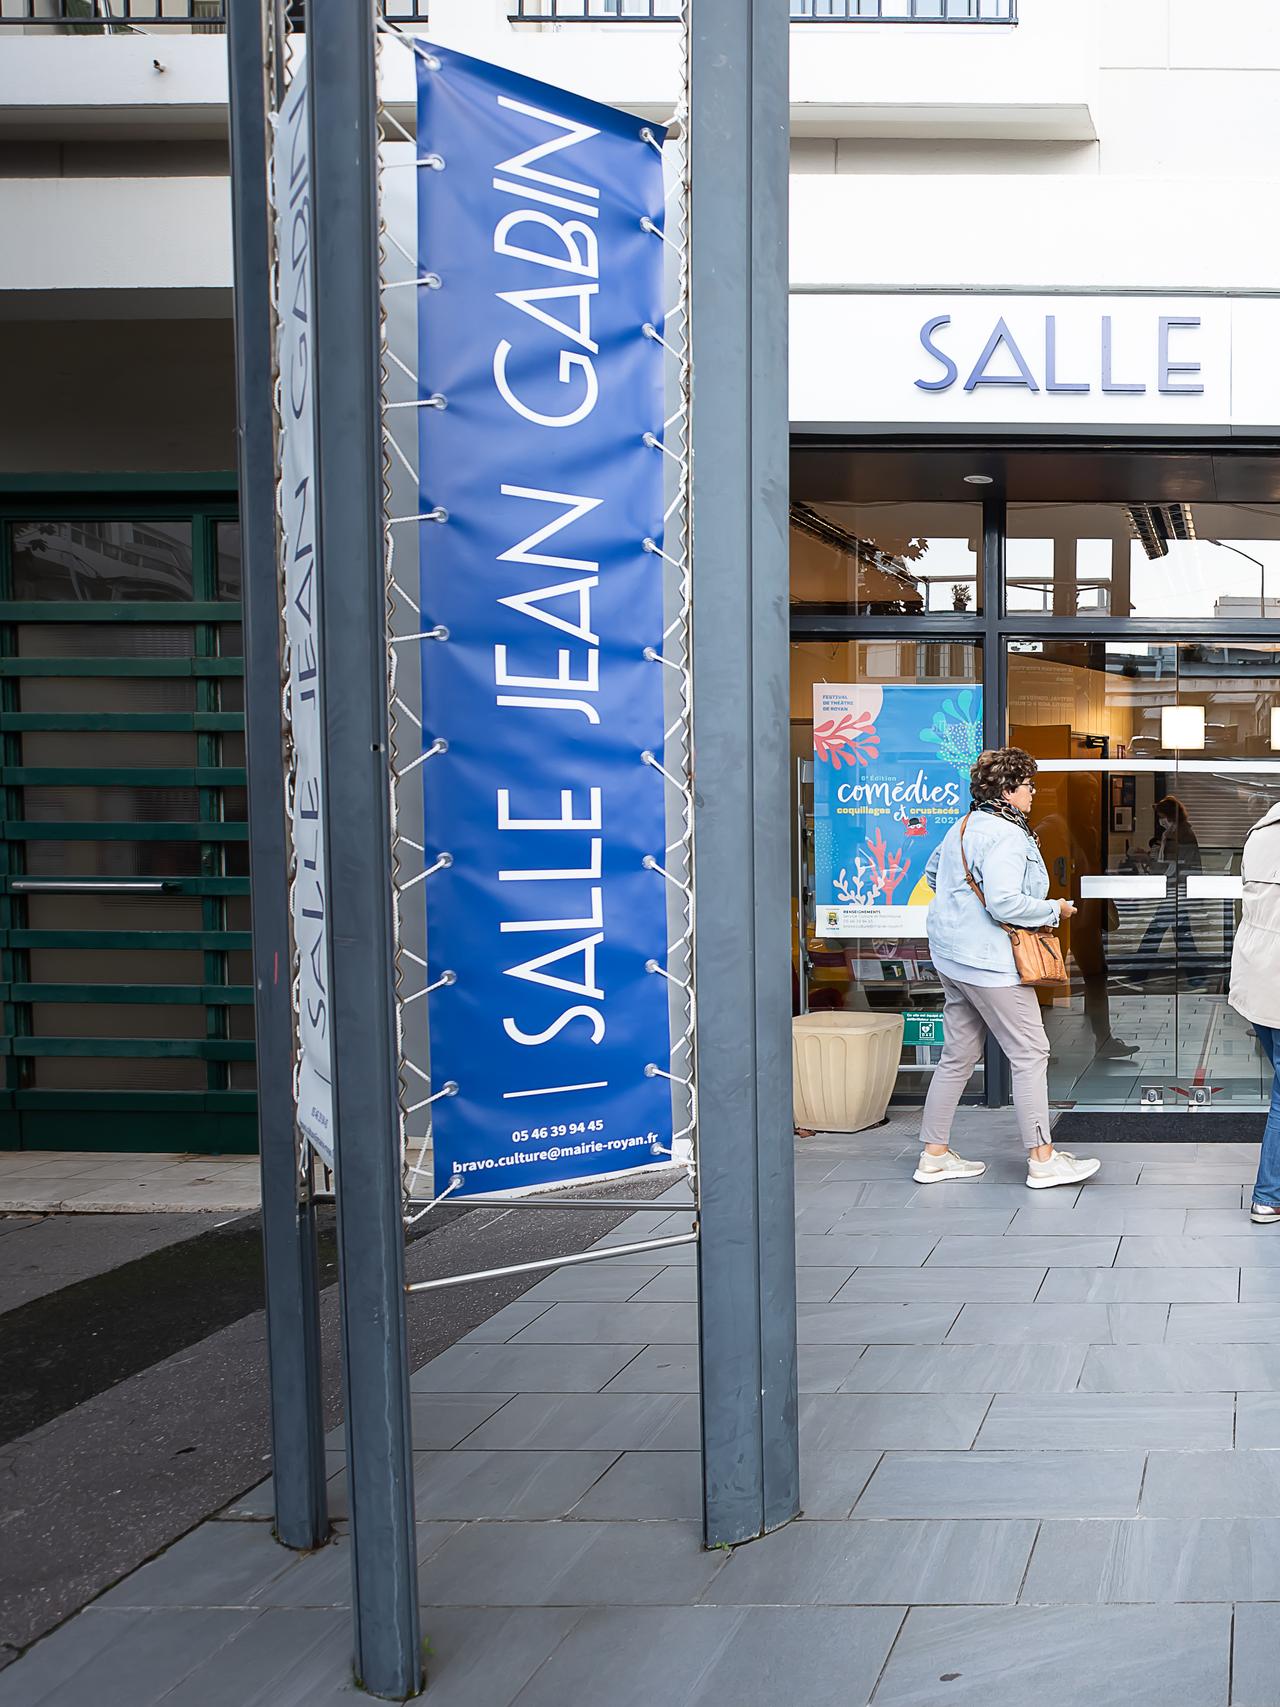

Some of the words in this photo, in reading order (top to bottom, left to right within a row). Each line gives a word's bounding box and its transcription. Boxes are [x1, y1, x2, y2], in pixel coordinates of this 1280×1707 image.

[493, 95, 602, 428] GABIN
[914, 315, 1204, 395] SALLE
[495, 483, 605, 725] JEAN
[837, 769, 960, 807] comédies
[837, 806, 891, 816] coquillages
[893, 804, 909, 821] et
[909, 806, 960, 815] crustacés
[497, 786, 606, 1046] SALLE
[452, 1132, 659, 1174] bravo.culture@mairie-royan.fr
[512, 1130, 529, 1143] 05
[531, 1127, 548, 1141] 46
[550, 1124, 567, 1138] 39
[569, 1122, 585, 1135] 94
[587, 1119, 604, 1132] 45
